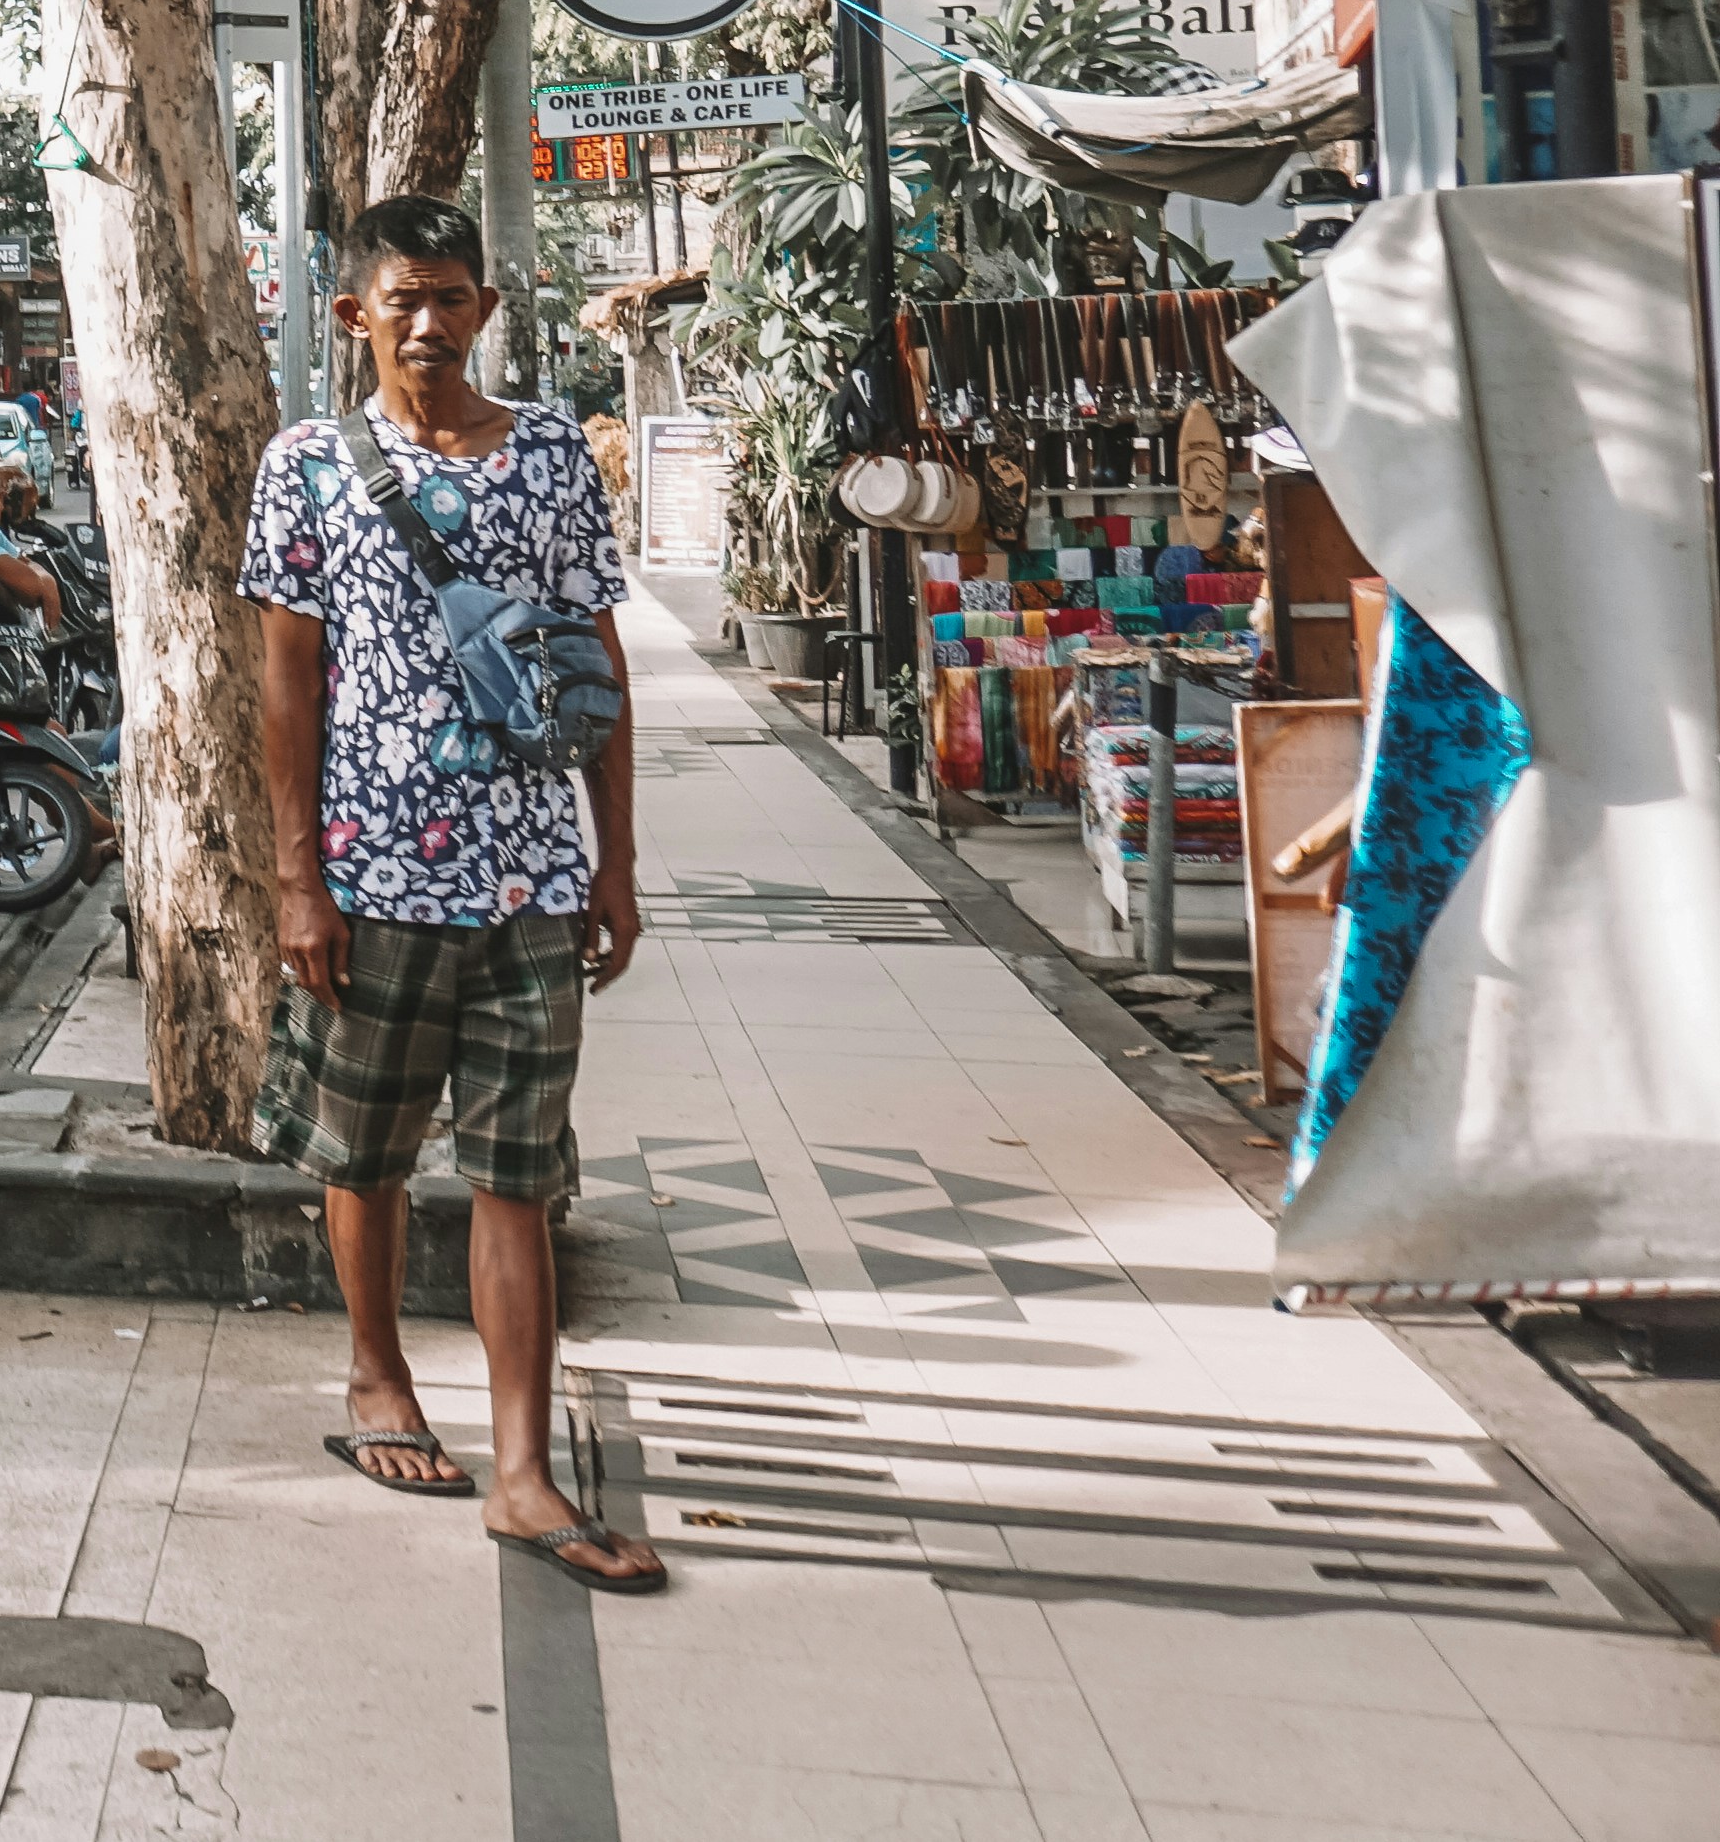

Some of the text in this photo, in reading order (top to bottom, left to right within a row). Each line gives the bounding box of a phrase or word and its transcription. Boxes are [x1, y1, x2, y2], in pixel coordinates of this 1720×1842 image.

[549, 92, 595, 110] ONE
[601, 88, 667, 107] TRIBE
[686, 83, 733, 101] ONE
[741, 79, 789, 98] LIFE
[572, 103, 752, 129] LOUNGE & CAFE
